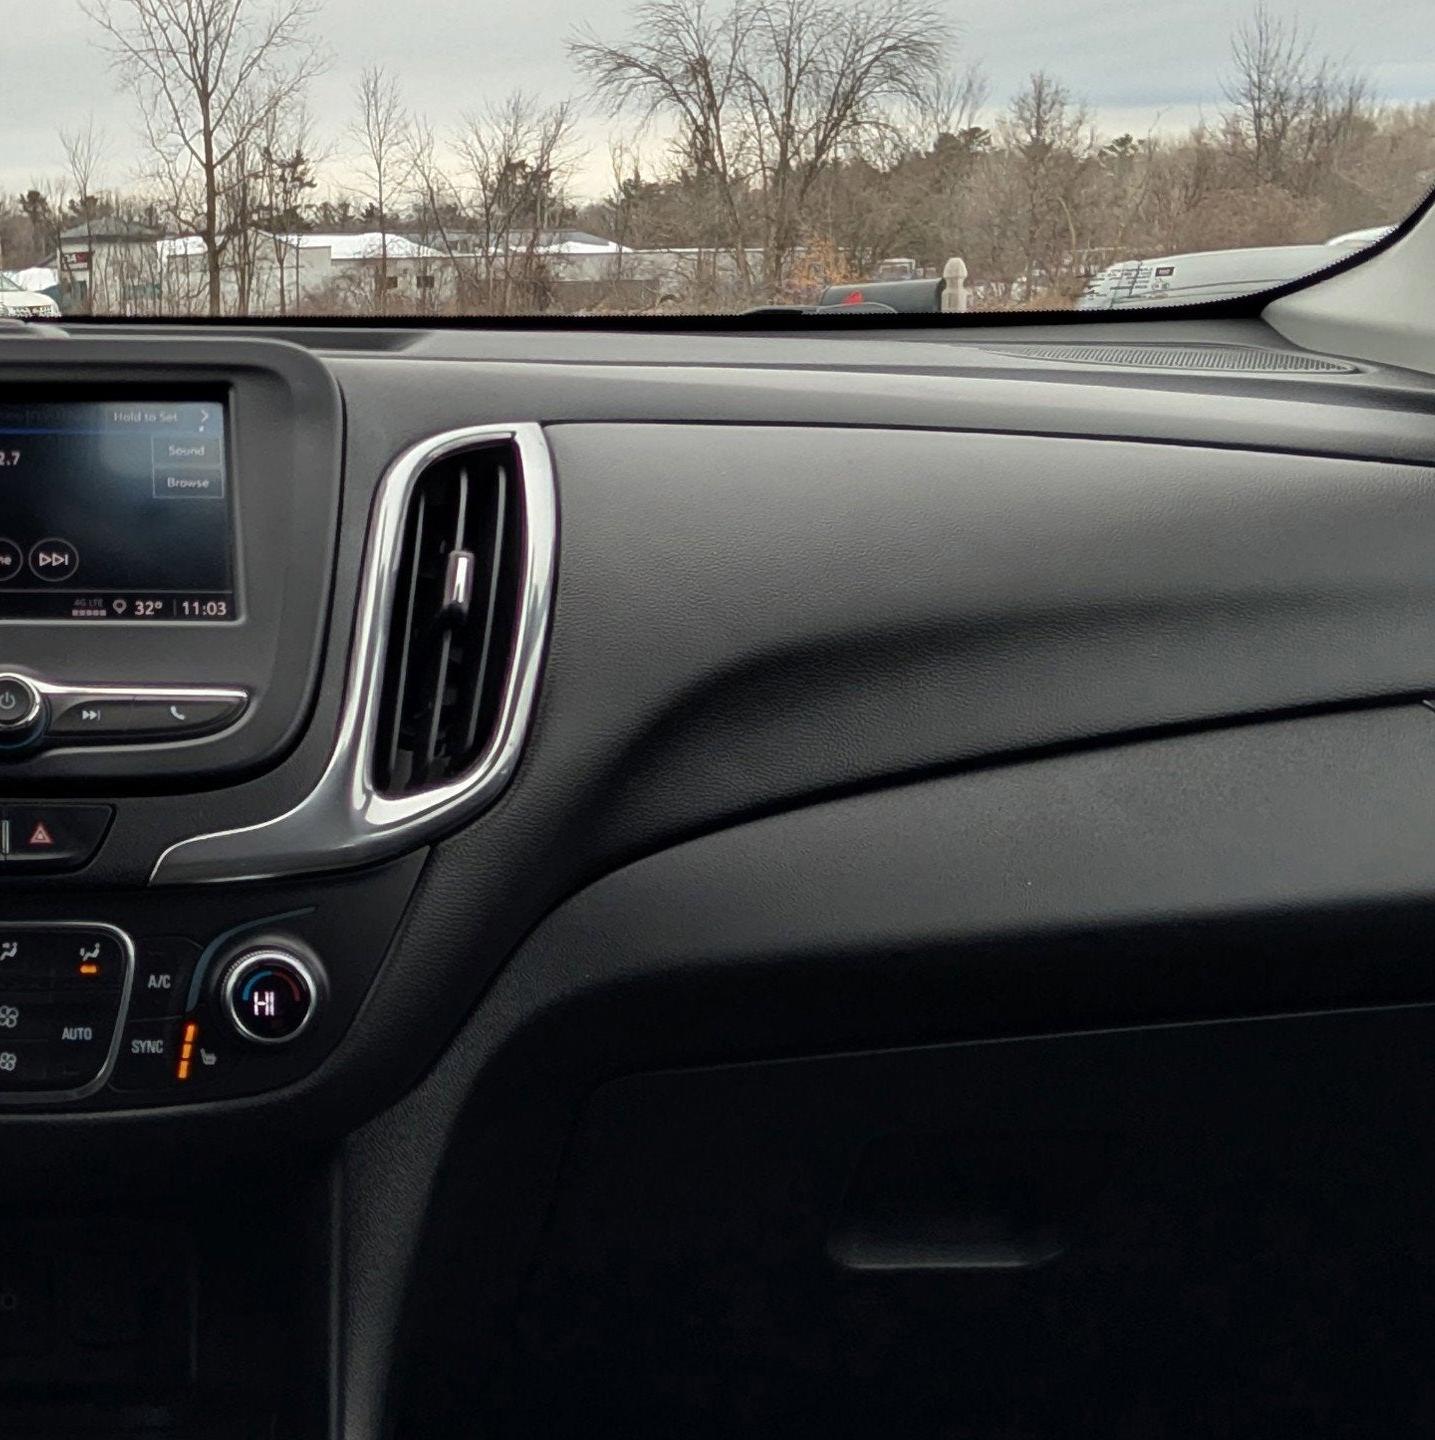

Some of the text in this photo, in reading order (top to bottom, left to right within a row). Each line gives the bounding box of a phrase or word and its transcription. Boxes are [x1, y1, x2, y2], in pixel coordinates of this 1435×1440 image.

[113, 411, 179, 423] Hold to Set
[168, 445, 205, 457] Sound
[166, 477, 210, 490] Browse
[182, 601, 228, 616] 11:03
[147, 974, 172, 991] A/C
[253, 990, 276, 1016] HI
[61, 1027, 93, 1042] AUTO
[131, 1039, 164, 1054] SYNC
